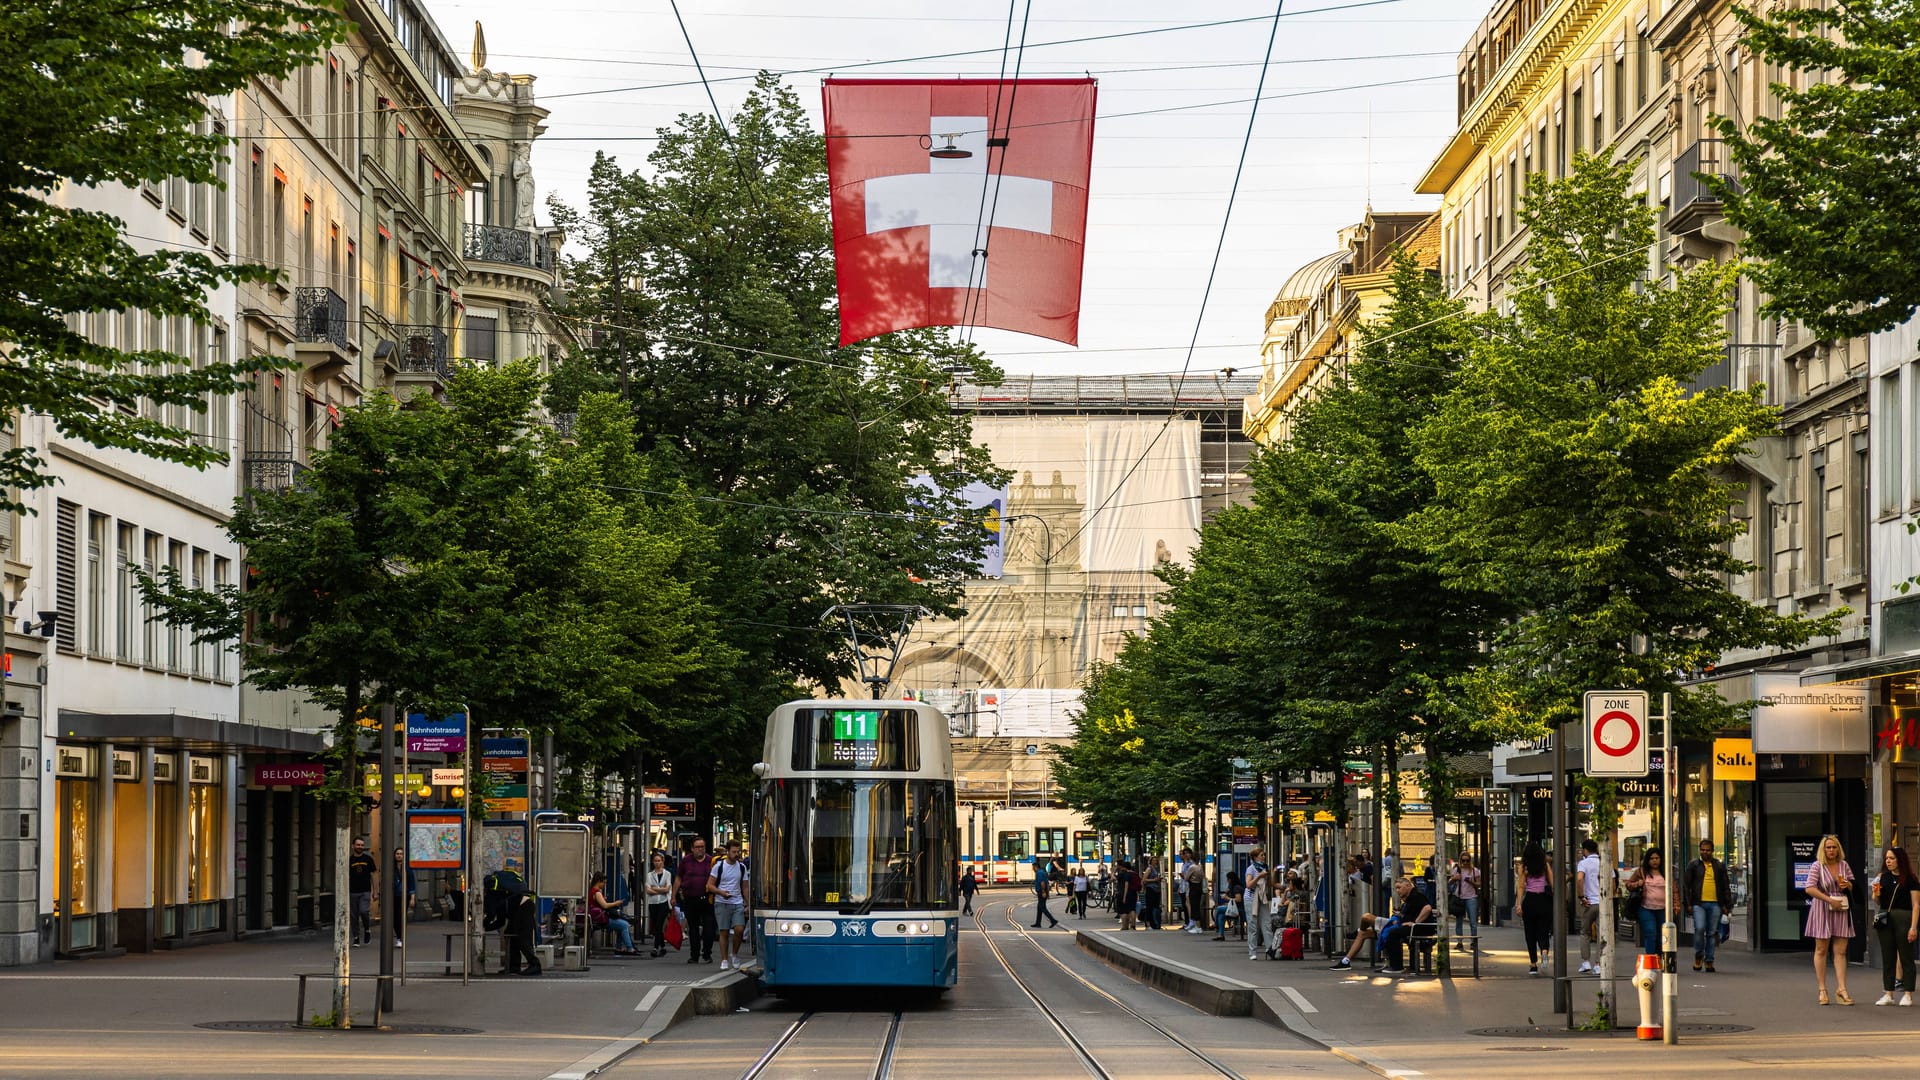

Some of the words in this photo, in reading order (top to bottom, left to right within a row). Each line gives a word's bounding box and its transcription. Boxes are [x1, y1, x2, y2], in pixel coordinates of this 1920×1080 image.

[1604, 700, 1630, 709] ZONE
[841, 714, 866, 736] 11
[412, 742, 421, 751] 17
[834, 743, 878, 764] Rehalp
[1716, 753, 1753, 767] Salt.
[1622, 780, 1660, 792] GÖTTE
[1533, 788, 1553, 798] GÖT
[827, 894, 838, 902] 07
